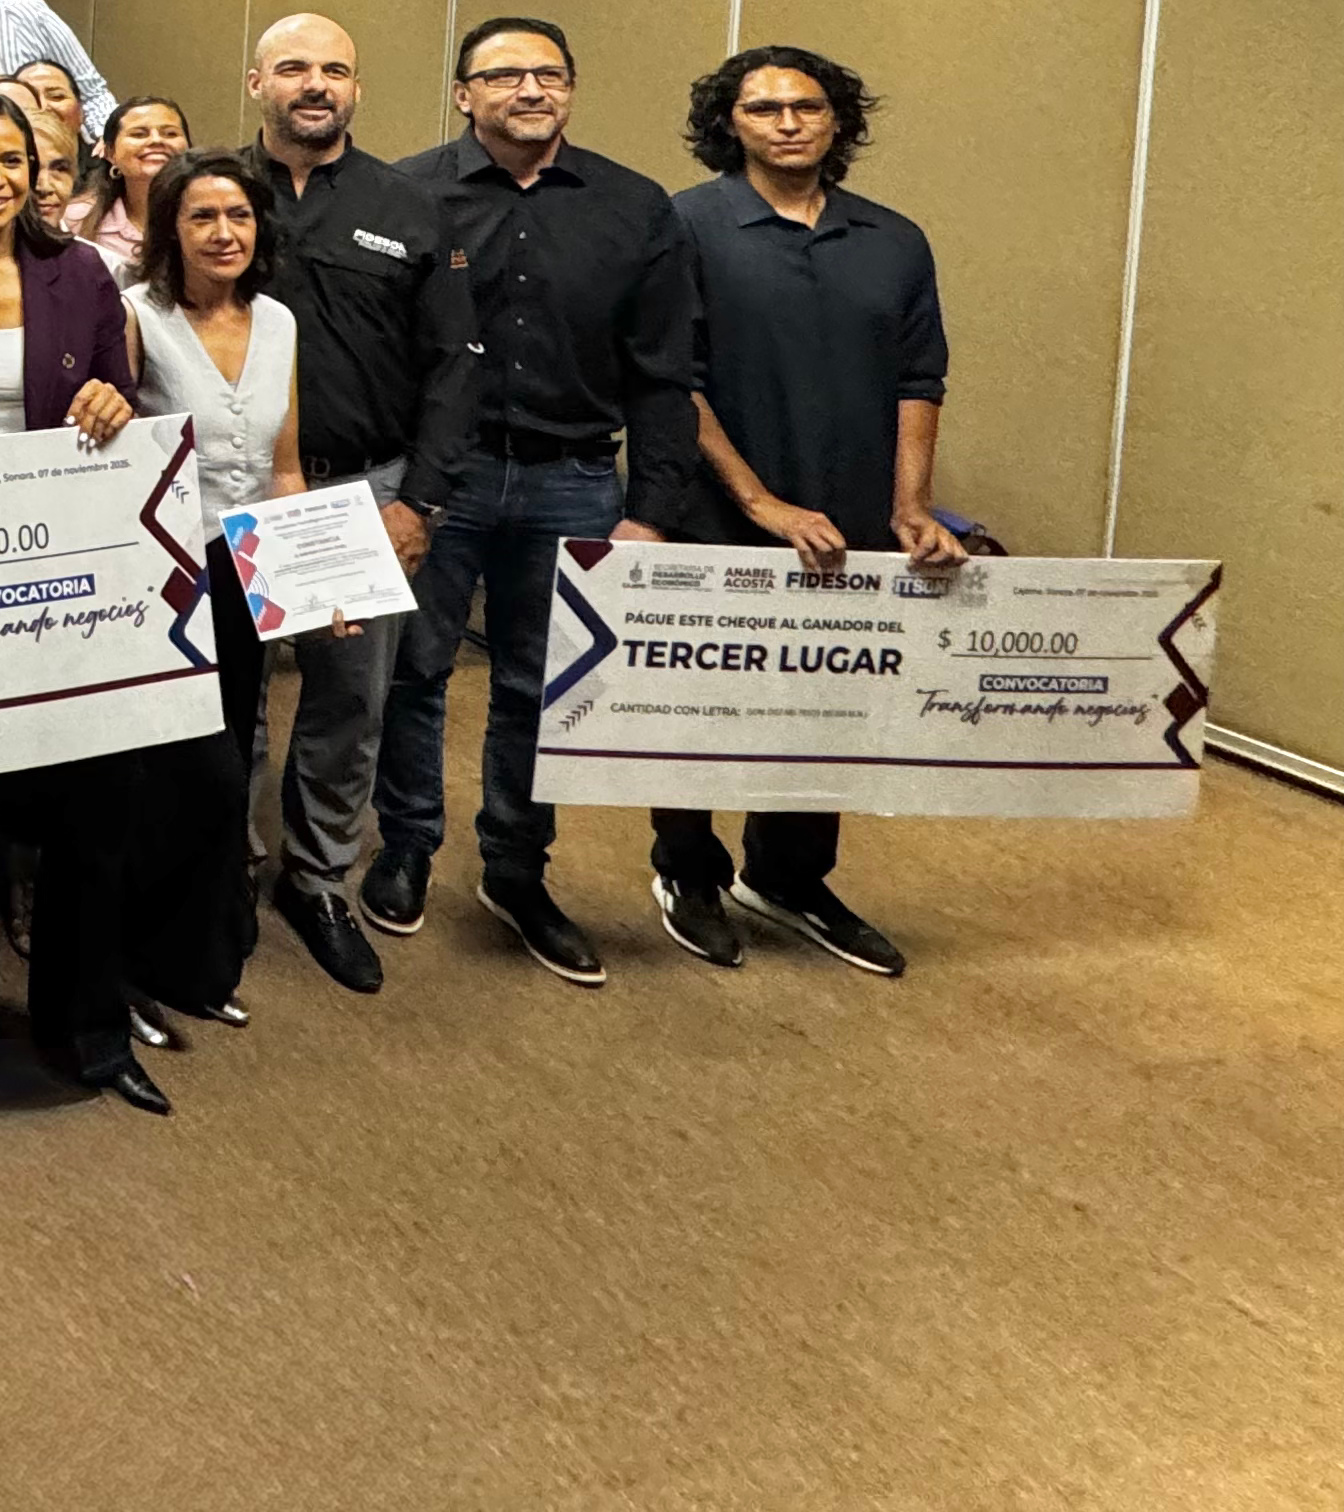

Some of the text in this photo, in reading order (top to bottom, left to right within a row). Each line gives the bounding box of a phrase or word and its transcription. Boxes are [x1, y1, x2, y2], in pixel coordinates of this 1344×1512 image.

[38, 468, 49, 478] 07
[51, 467, 62, 477] de
[64, 462, 108, 476] noviembre
[724, 567, 776, 579] ANABEL
[786, 571, 881, 591] FIDESON
[724, 577, 775, 589] ACOSTA
[624, 610, 905, 634] PÁGUE ESTE CHEQUE AL GANADOR DEL
[937, 628, 1078, 657] $ 10,000.00
[622, 639, 903, 676] TERCER LUGAR
[982, 677, 1105, 691] CONVOCATORIA
[610, 703, 672, 715] CANTIDAD
[674, 705, 700, 716] CON
[702, 706, 742, 717] LETRA:
